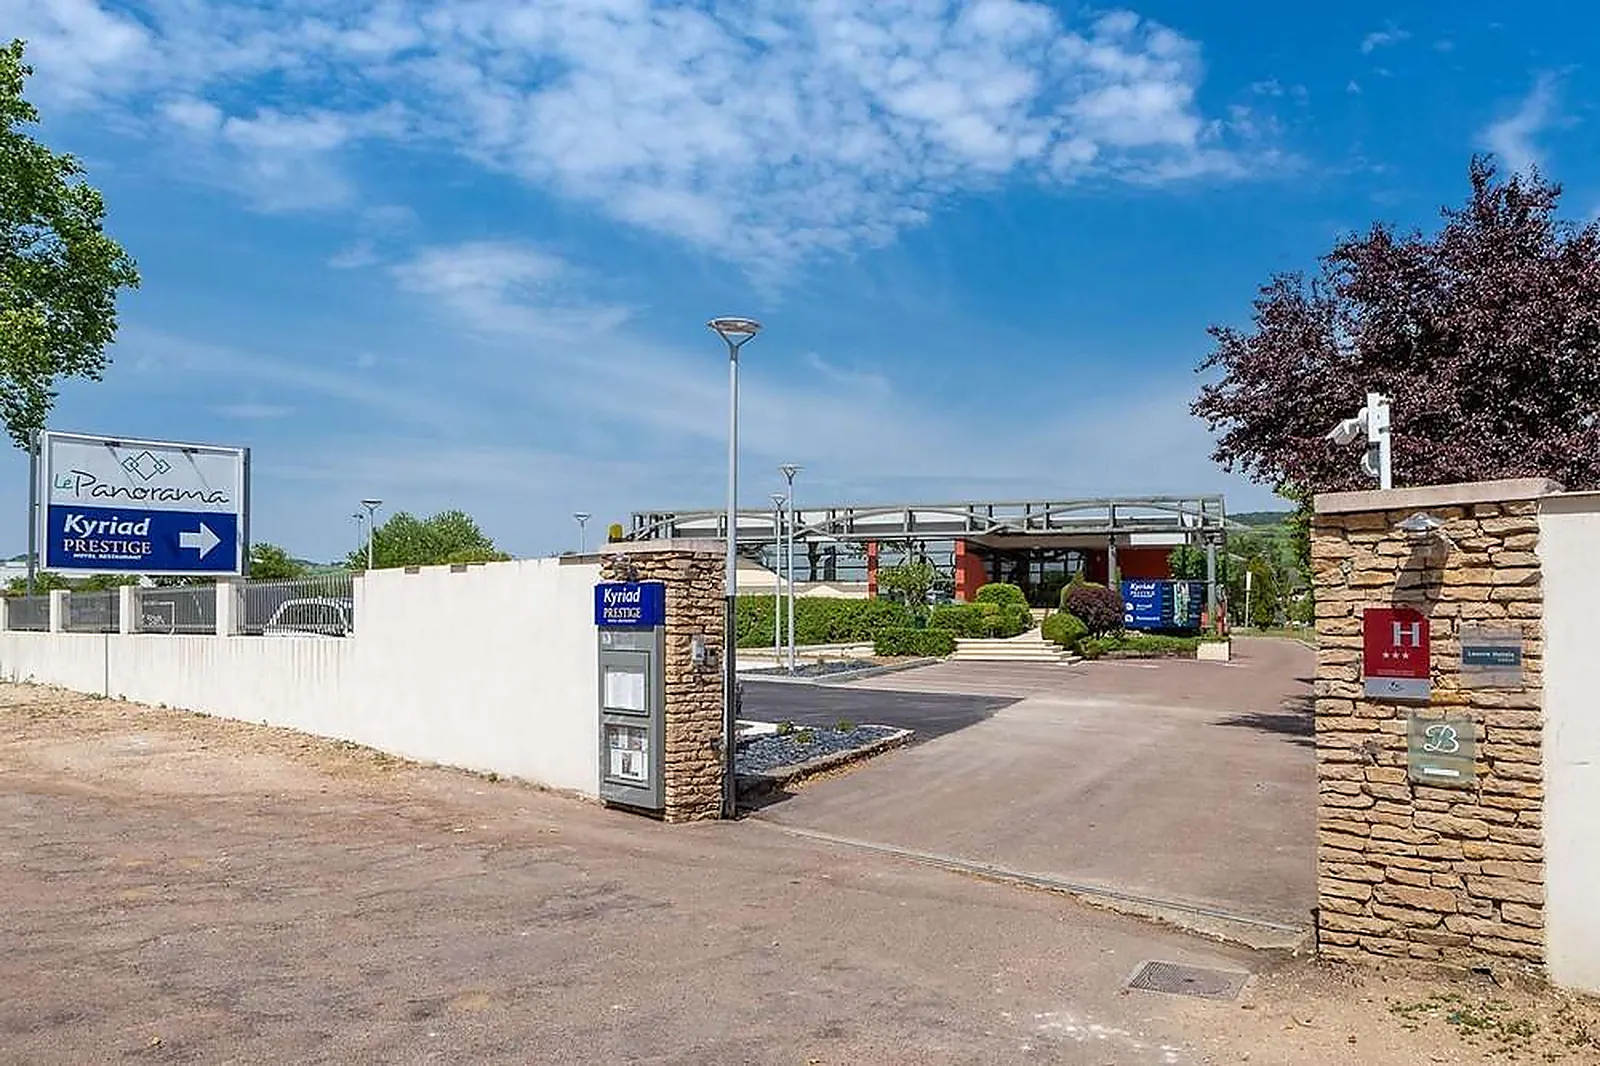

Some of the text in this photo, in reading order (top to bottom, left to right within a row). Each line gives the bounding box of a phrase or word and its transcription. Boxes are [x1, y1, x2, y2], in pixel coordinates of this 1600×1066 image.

[54, 469, 229, 503] Le Panorama
[64, 513, 151, 538] Kyriad
[64, 538, 152, 554] PRESTIGE
[603, 586, 641, 607] Kyriad
[603, 607, 642, 618] PRESTIGE
[1392, 621, 1420, 648] H
